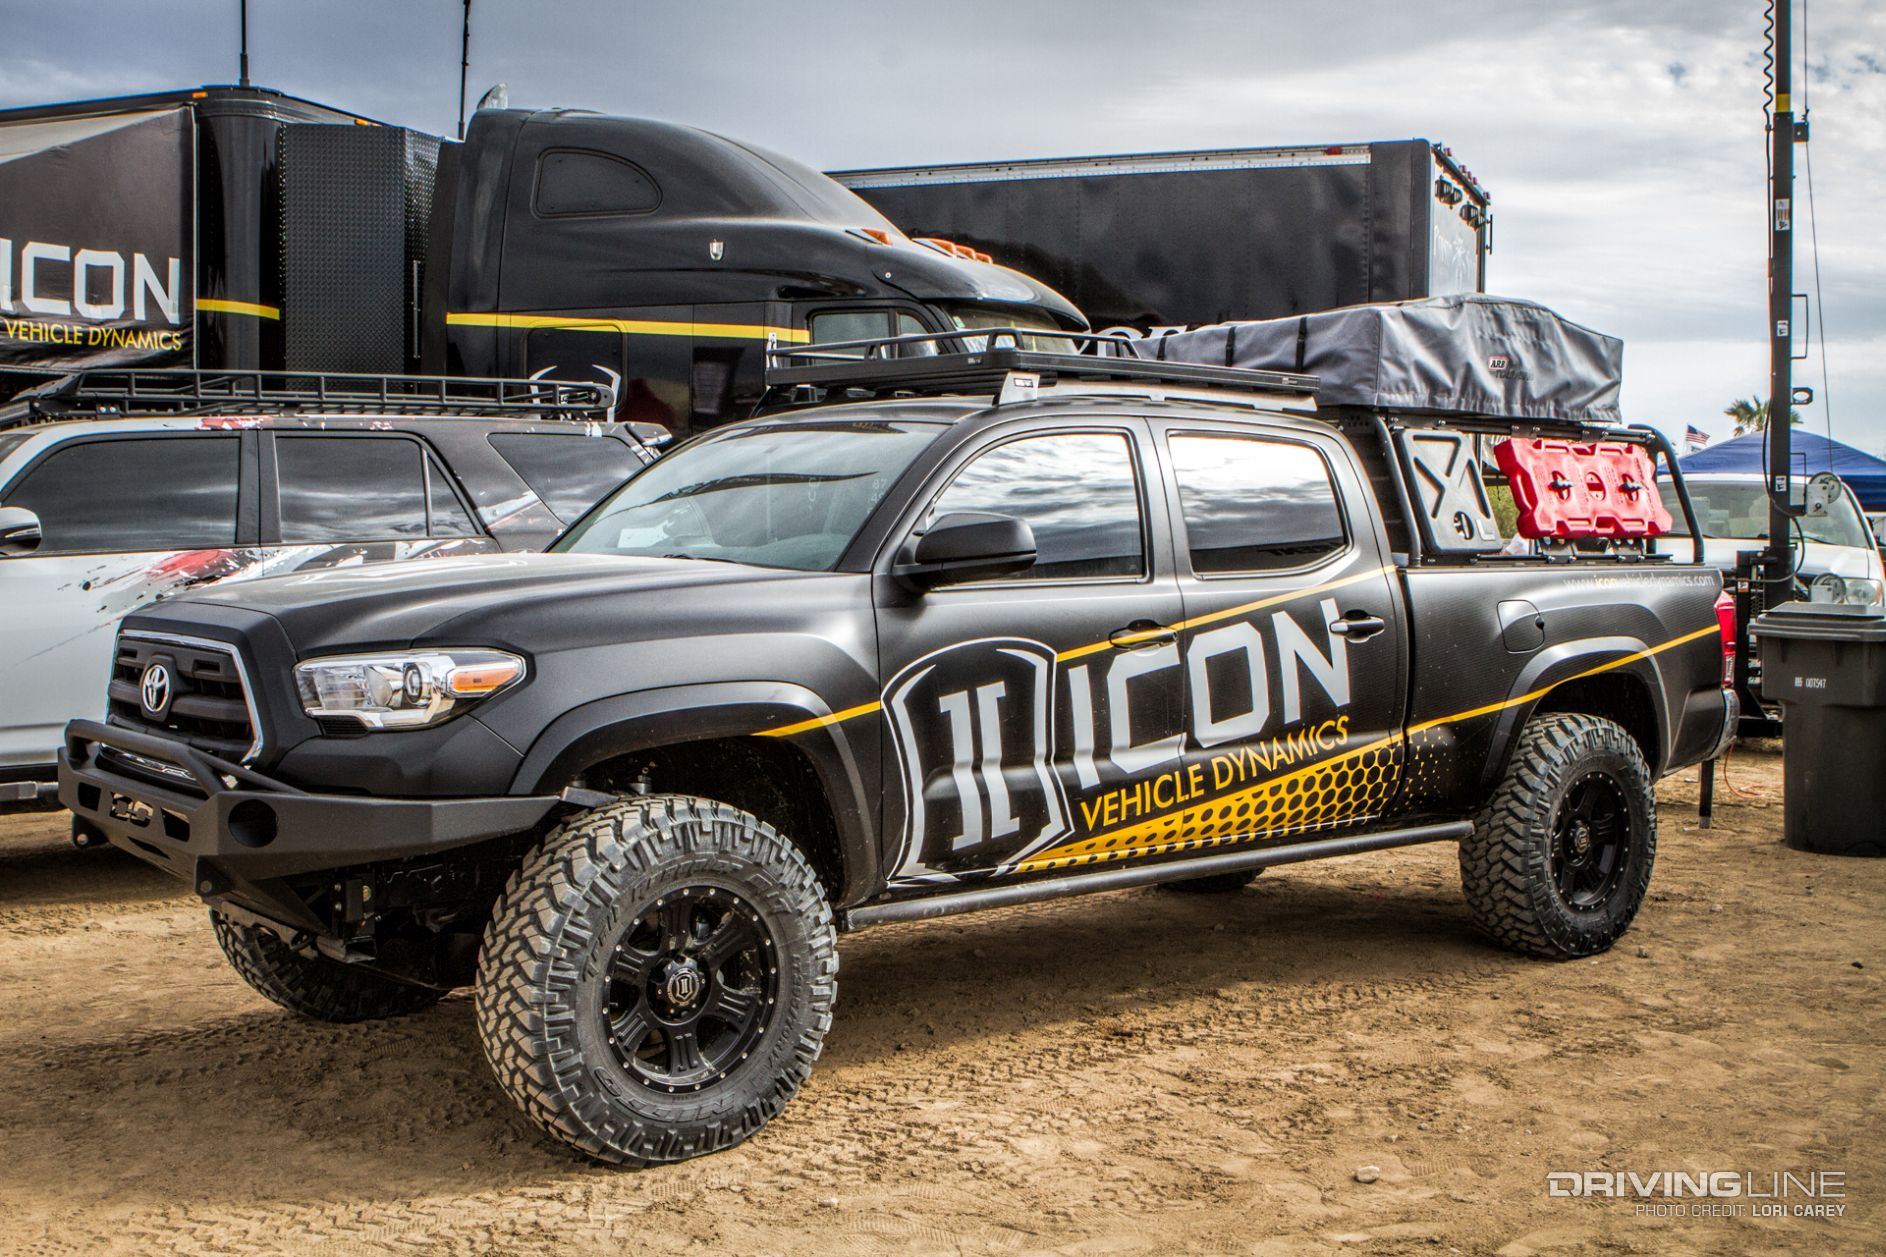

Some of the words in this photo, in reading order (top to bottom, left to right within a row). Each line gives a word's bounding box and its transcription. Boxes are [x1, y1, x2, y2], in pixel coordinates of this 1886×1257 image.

[0, 238, 180, 324] ICON
[4, 319, 83, 345] VEHICLE
[88, 327, 182, 351] DYNAMICS
[1066, 598, 1350, 788] ICON
[1080, 763, 1204, 832] VEHICLE
[1213, 715, 1349, 787] DYNAMICS
